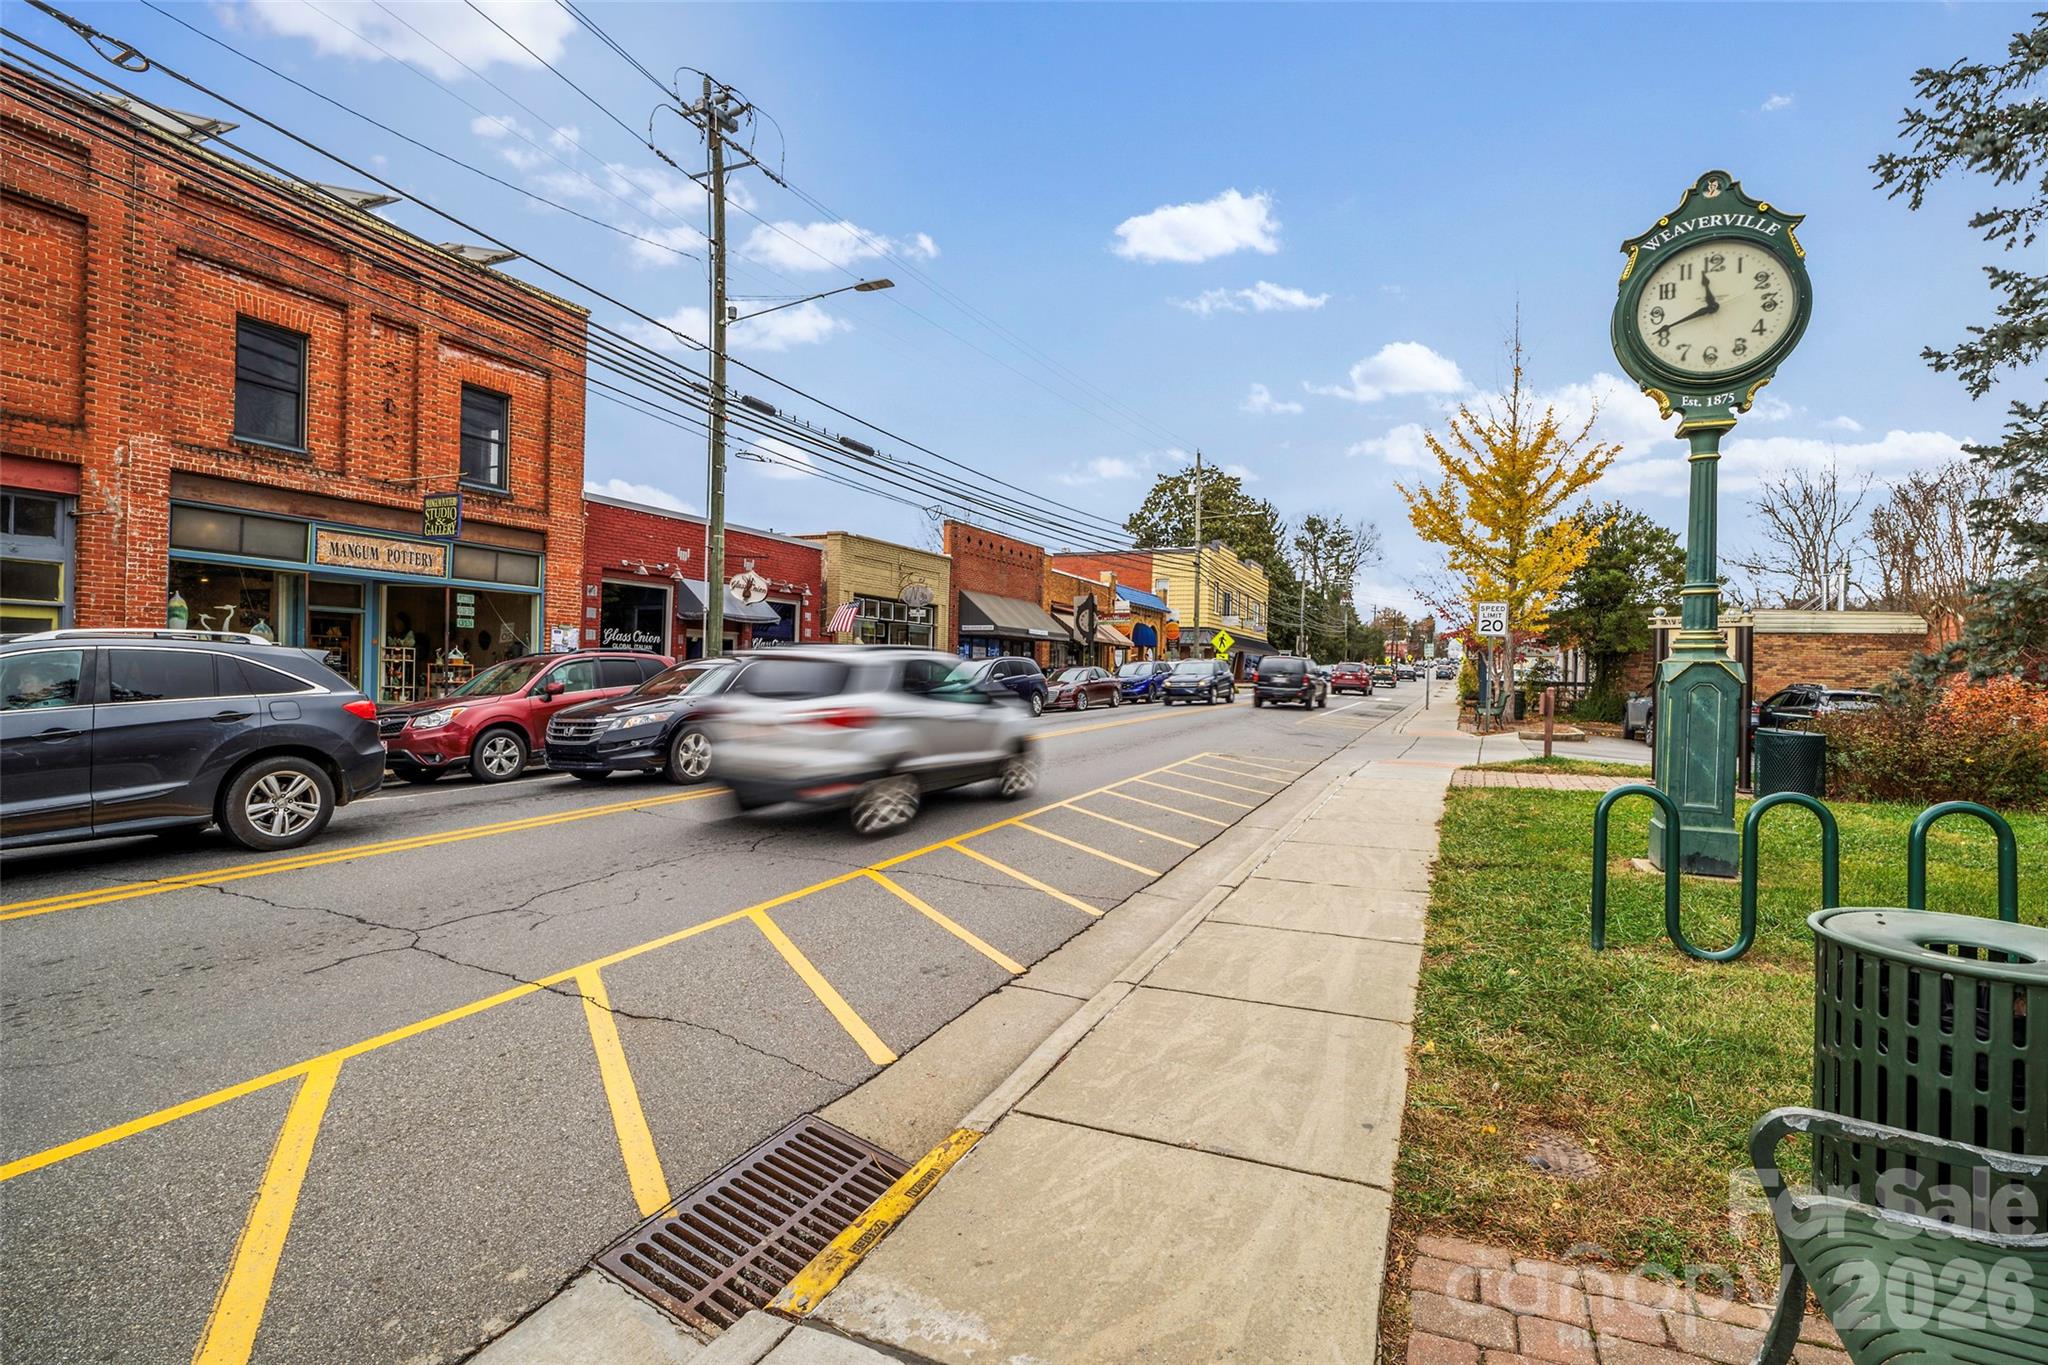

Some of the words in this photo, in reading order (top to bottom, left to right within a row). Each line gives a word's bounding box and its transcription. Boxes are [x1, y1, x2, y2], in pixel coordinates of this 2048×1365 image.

[1641, 213, 1782, 252] WEAVERVILLE
[1703, 254, 1725, 273] 12
[1737, 257, 1743, 273] 1
[1680, 264, 1692, 281] 11
[1755, 271, 1771, 289] 2
[1659, 283, 1676, 300] 10
[1761, 293, 1778, 312] 3
[1650, 306, 1665, 325] 9
[1752, 318, 1767, 335] 4
[1657, 326, 1670, 347] 8
[1677, 344, 1692, 361] 7
[1703, 346, 1719, 364] 6
[1732, 338, 1748, 356] 5
[1682, 395, 1702, 407] Est.
[1707, 393, 1735, 406] 1875
[425, 507, 457, 522] STUDIO
[424, 521, 457, 536] GALLERY
[329, 541, 379, 560] MANGUM
[387, 549, 434, 567] POTTERY
[1481, 620, 1503, 632] 20
[603, 628, 631, 645] Glass
[633, 630, 662, 643] Onion
